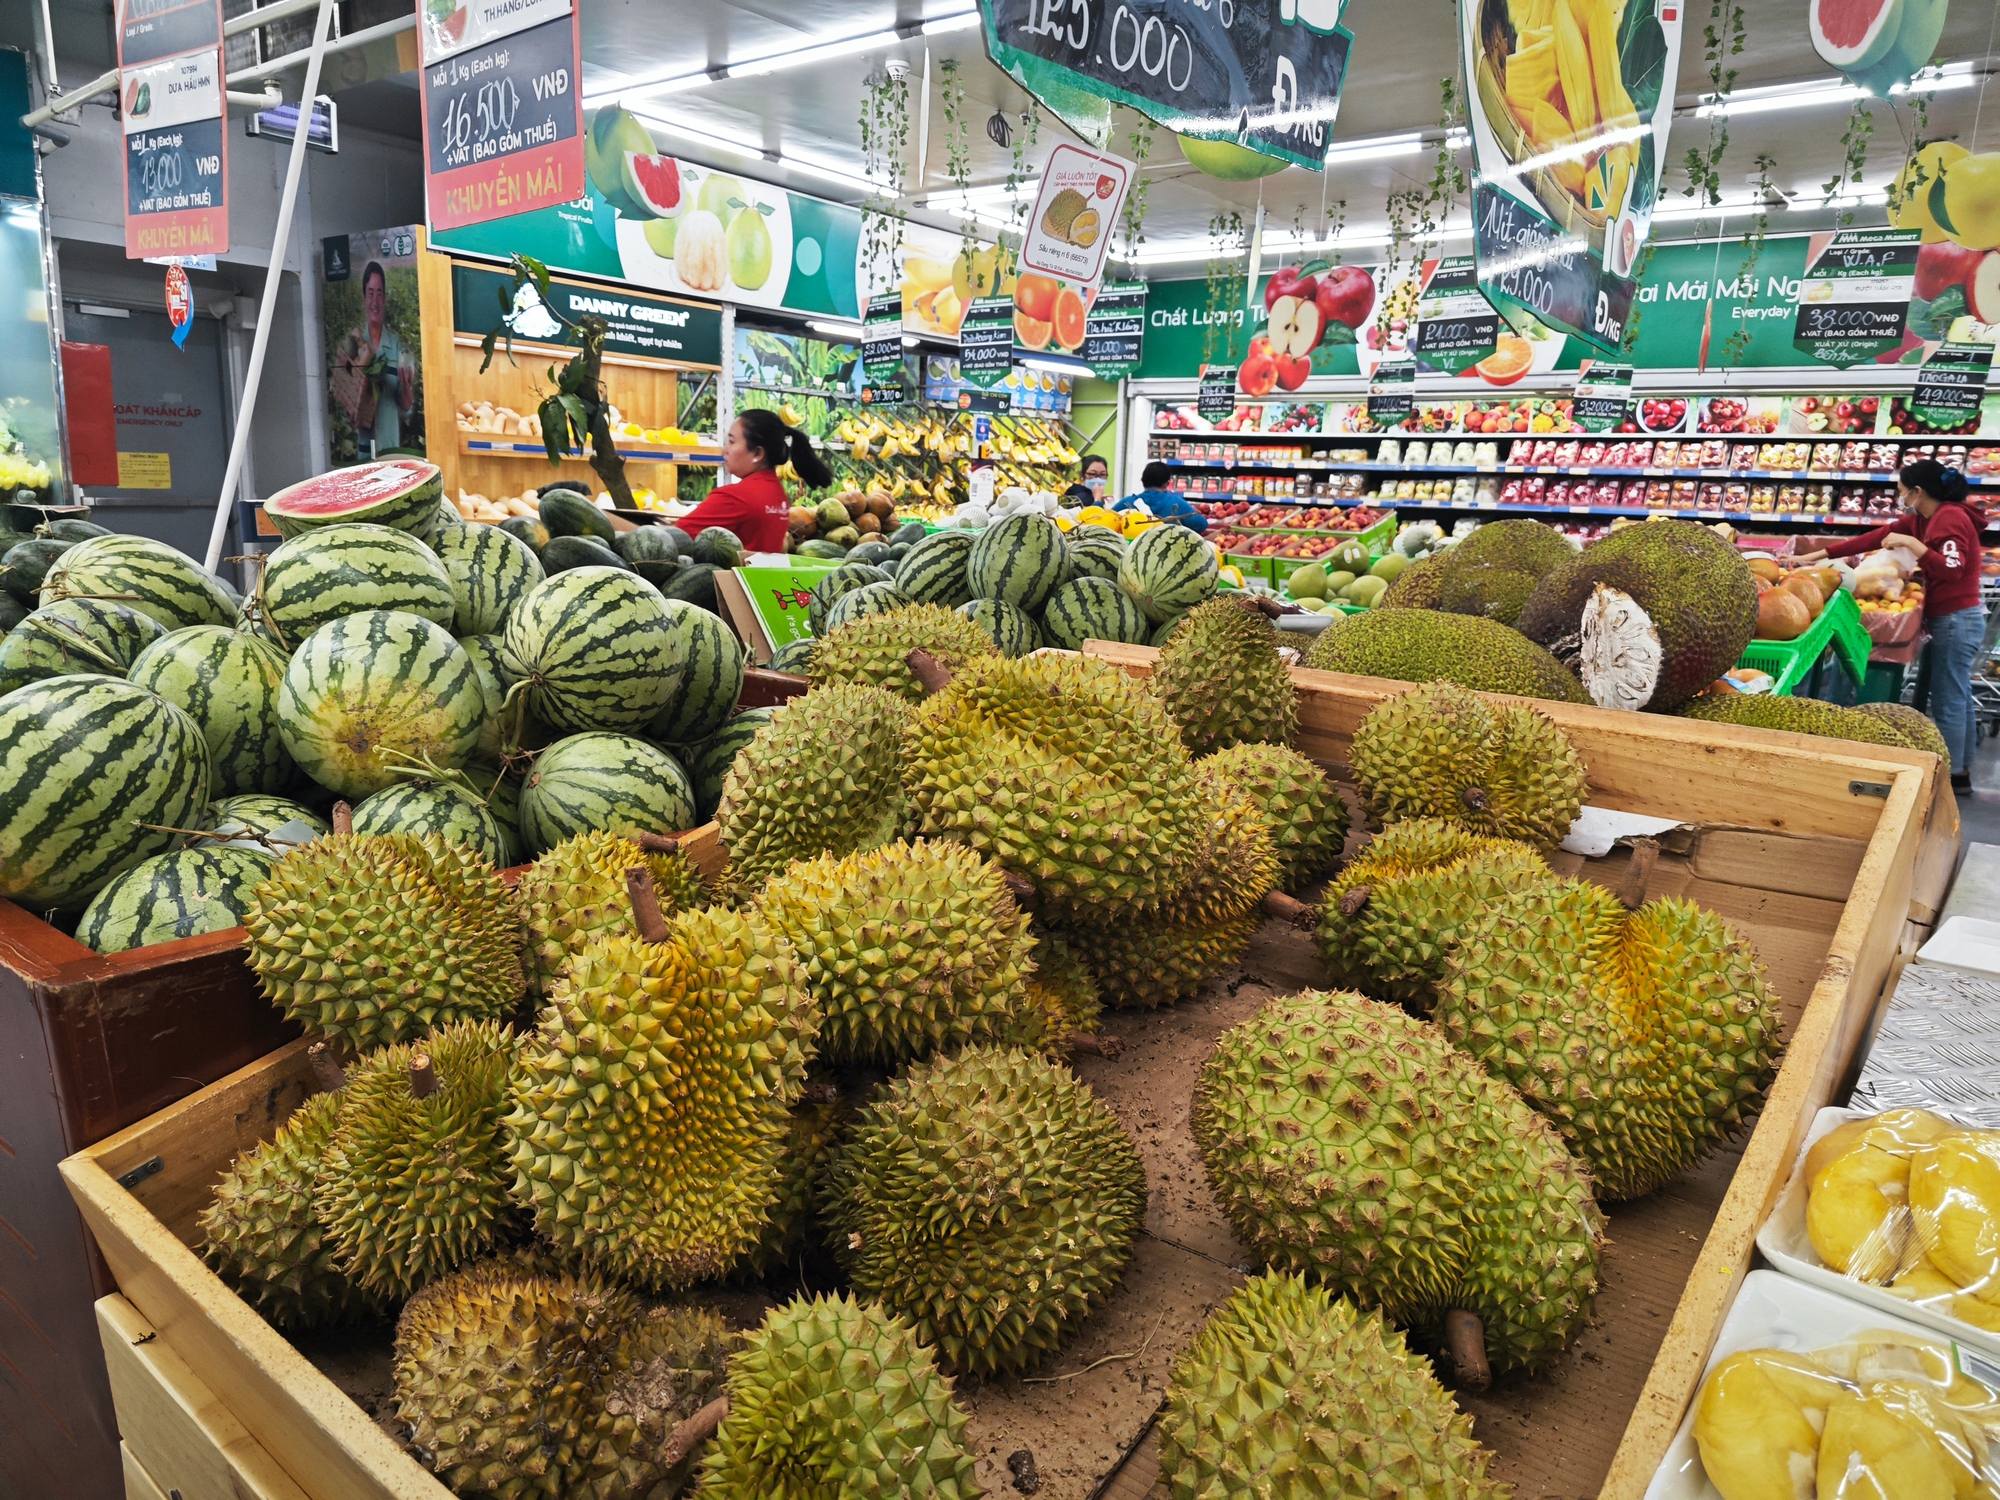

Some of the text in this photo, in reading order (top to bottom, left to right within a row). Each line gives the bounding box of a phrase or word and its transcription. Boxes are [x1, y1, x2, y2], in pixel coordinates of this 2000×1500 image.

[459, 67, 470, 80] Kg
[470, 59, 494, 77] (Each
[532, 68, 569, 101] VNĐ
[447, 113, 557, 166] +VAT (BAO GỒM THUẾ)
[196, 155, 219, 176] VNĐ
[1055, 171, 1067, 180] GIÁ
[1086, 171, 1099, 181] TỐT
[446, 157, 563, 216] KHUYẾN MÃI
[139, 186, 211, 212] +VAT (BAO GỒM THUẾ)
[557, 210, 578, 221] Tropical
[137, 215, 214, 251] KHUYẾN MÃI
[1665, 280, 1709, 301] Mới
[1715, 273, 1760, 299] Mỗi
[569, 294, 630, 319] DANNY
[1151, 308, 1189, 327] Chất
[1192, 307, 1244, 327] Lượng
[1732, 304, 1792, 320] Everyday
[1475, 325, 1493, 334] VNĐ
[1809, 309, 1876, 330] 38.000
[1875, 314, 1899, 323] VNĐ
[1438, 340, 1454, 349] (BAO
[1455, 337, 1470, 347] GỒM
[1472, 335, 1492, 346] THUẾ)
[1801, 325, 1898, 338] +VAT (BAO GỒM THUẾ)
[116, 418, 163, 427] EMERGENCY
